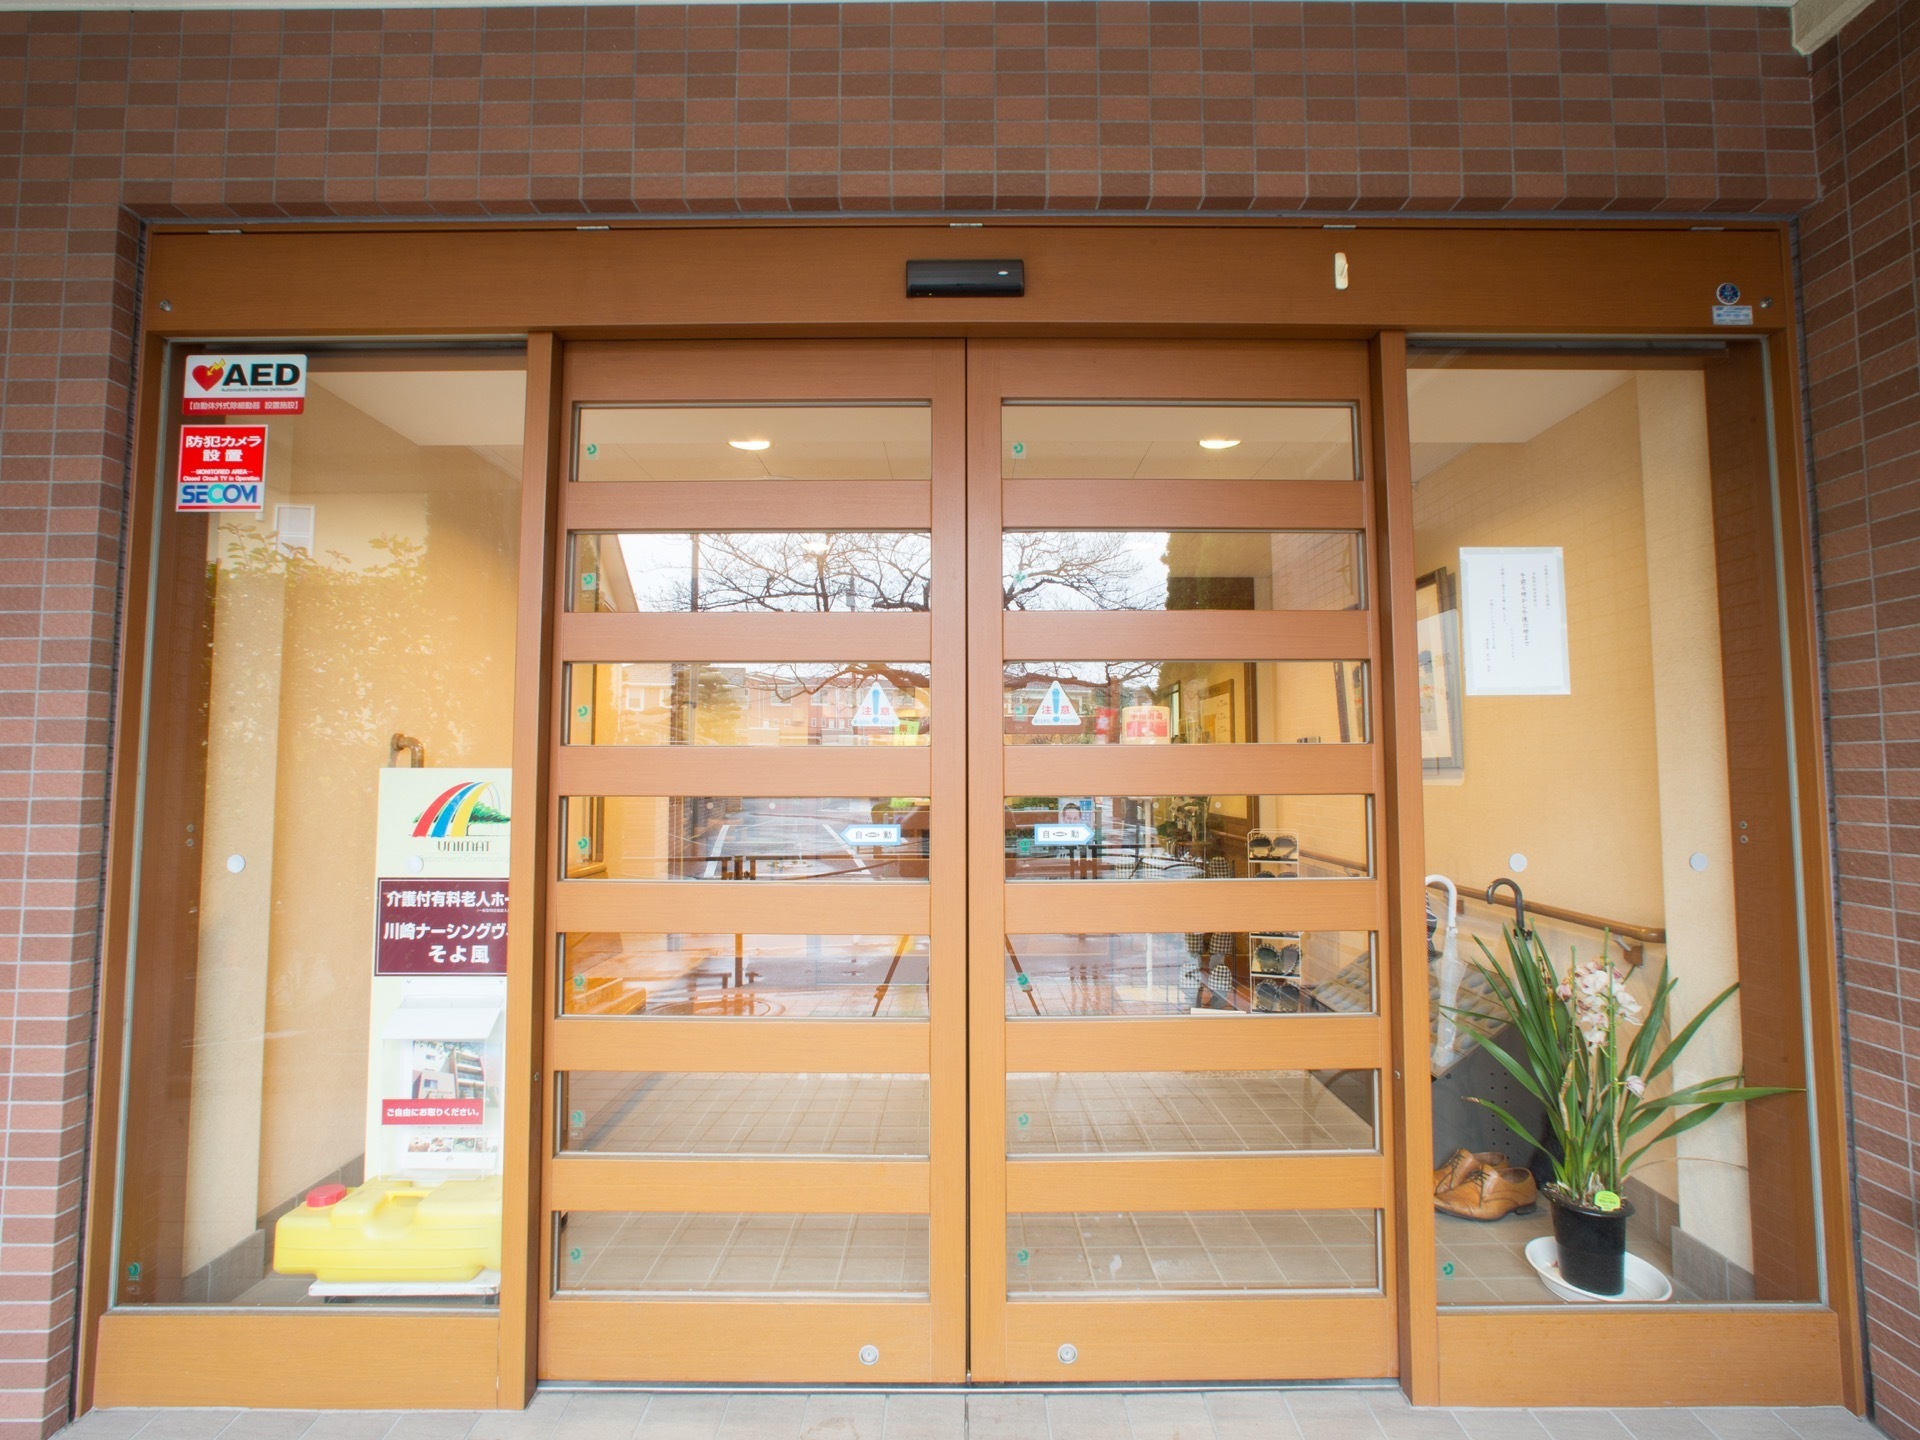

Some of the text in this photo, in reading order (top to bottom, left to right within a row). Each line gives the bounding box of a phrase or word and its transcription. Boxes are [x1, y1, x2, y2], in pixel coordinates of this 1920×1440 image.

[222, 363, 301, 386] AED
[185, 435, 262, 448] 防犯カメラ
[203, 449, 243, 462] 設置
[182, 484, 258, 503] SECOM
[437, 840, 491, 852] UNIMAT
[383, 922, 508, 940] 川崎ナーシングヴ
[428, 945, 490, 963] そよ風
[386, 1107, 480, 1118] ご自由にお取りください。
